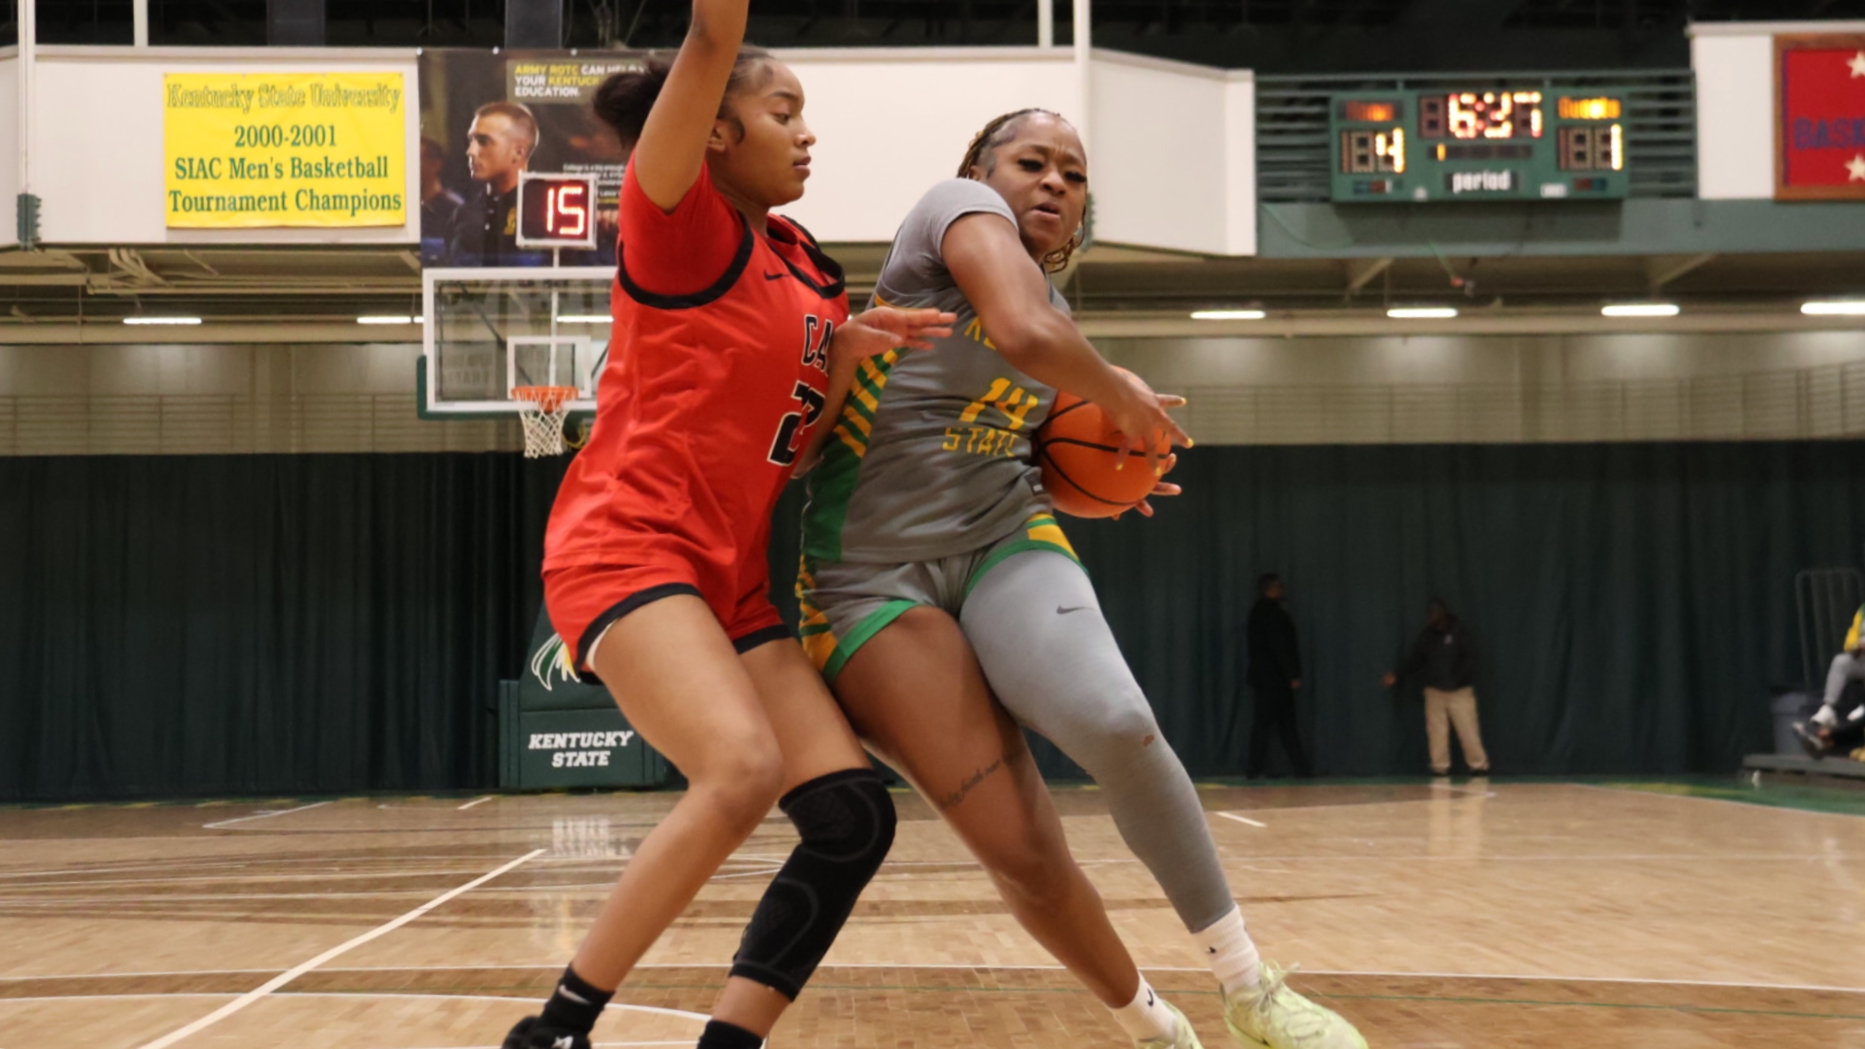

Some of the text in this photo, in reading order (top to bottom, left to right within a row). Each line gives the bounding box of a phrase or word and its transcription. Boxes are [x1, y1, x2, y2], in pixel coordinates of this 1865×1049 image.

[515, 64, 547, 75] ARMY
[550, 64, 580, 75] ROTC
[581, 64, 605, 75] CAN
[515, 76, 546, 86] YOUR
[167, 83, 401, 114] Kentucky State University
[1448, 92, 1542, 138] 6:27
[234, 125, 337, 147] 2000-2001
[175, 156, 389, 179] SIAC Men's Basketball
[1452, 169, 1511, 194] period
[169, 188, 402, 217] Tournament Champions
[547, 186, 585, 235] 15
[960, 377, 1039, 430] 14
[528, 731, 634, 749] KENTUCKY
[552, 751, 611, 767] STATE
